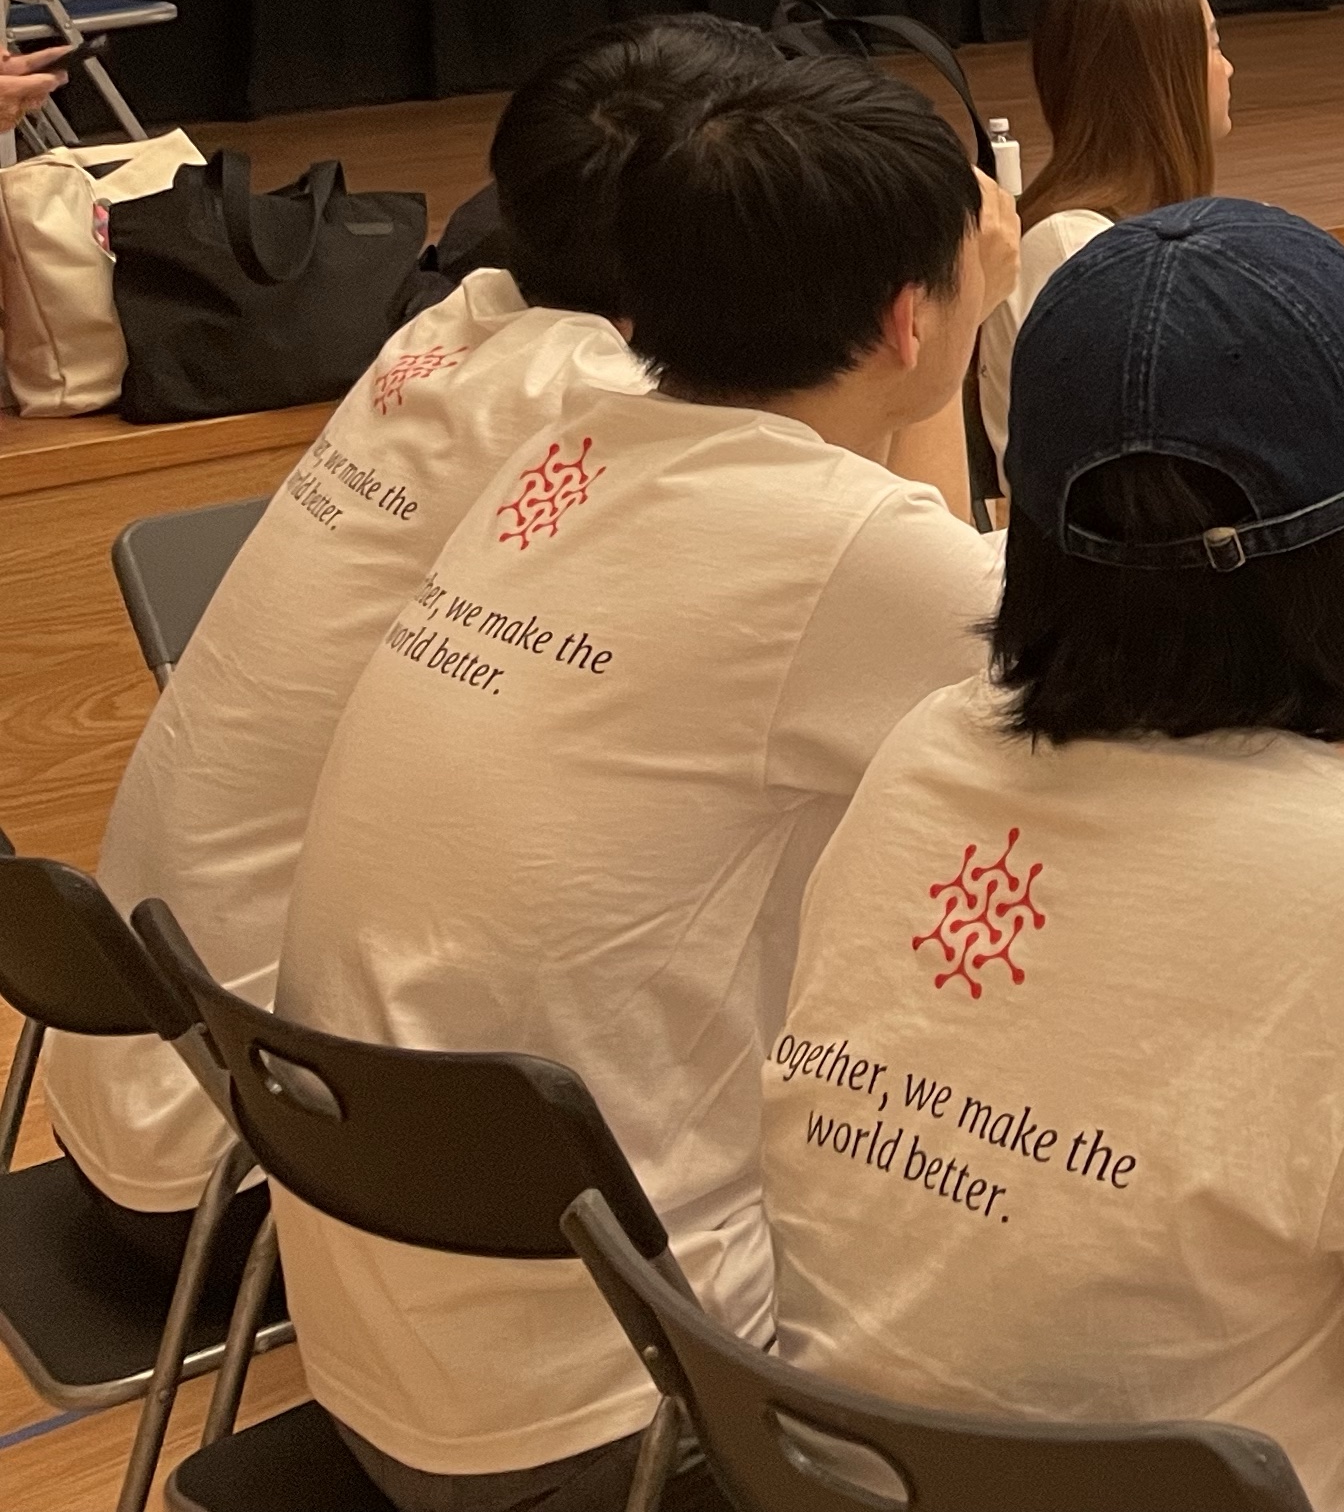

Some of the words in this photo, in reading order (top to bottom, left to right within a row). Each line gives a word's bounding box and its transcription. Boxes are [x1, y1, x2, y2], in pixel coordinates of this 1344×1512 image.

[338, 463, 381, 500] make
[379, 486, 418, 520] the
[427, 637, 504, 695] better.
[445, 596, 483, 627] we
[478, 615, 553, 653] make
[556, 633, 613, 674] the
[766, 1034, 888, 1112] ogether,
[905, 1074, 952, 1118] we
[957, 1096, 1057, 1162] make
[1066, 1130, 1137, 1189] the
[805, 1110, 902, 1173] world
[903, 1135, 1010, 1223] better.
